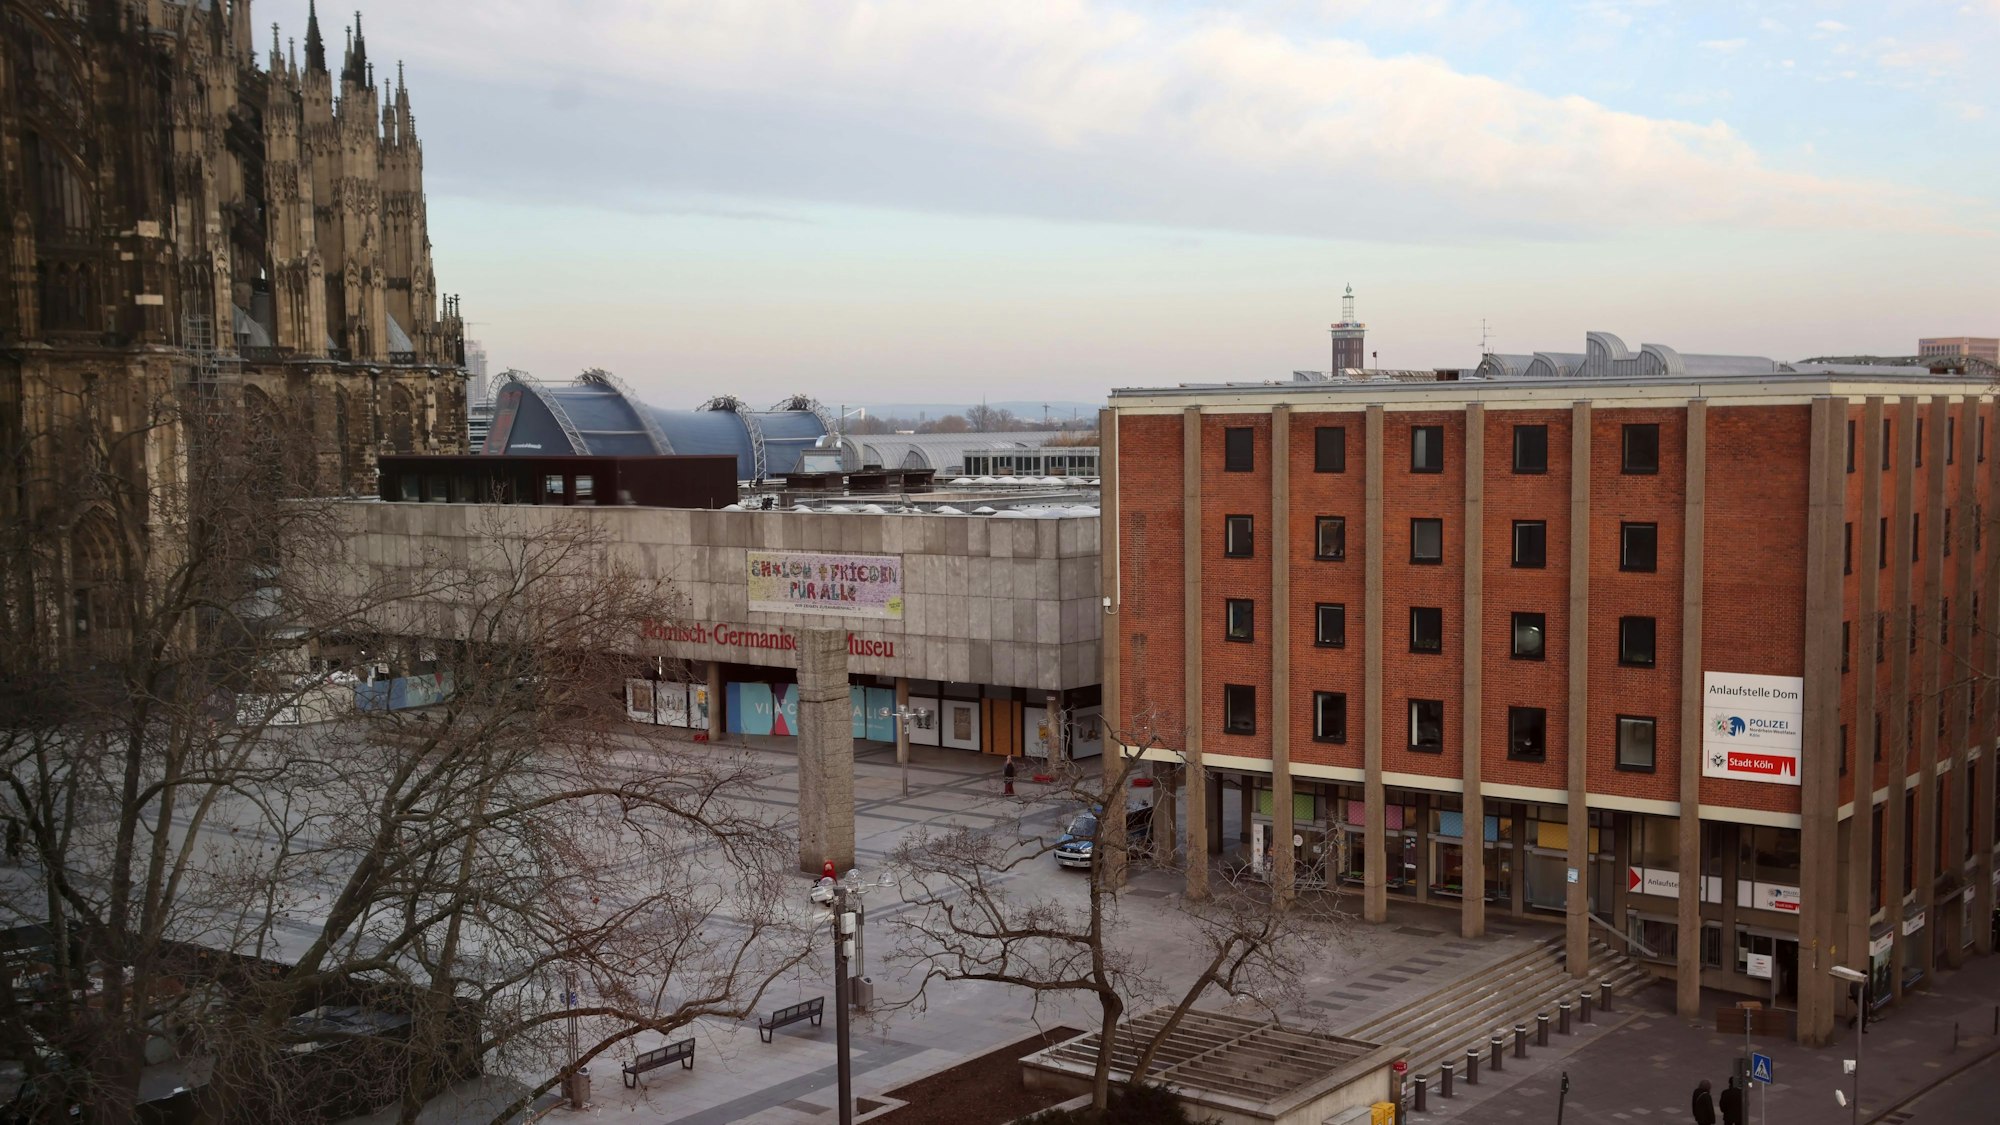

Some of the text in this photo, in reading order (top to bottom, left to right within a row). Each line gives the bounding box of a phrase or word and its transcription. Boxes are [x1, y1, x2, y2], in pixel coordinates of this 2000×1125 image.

[1709, 684, 1798, 699] Anlaufstelle Dom
[754, 702, 782, 716] VIA
[1749, 718, 1789, 730] POLIZEI
[1729, 757, 1774, 769] Stadt Köln
[1647, 878, 1679, 888] Anlaufste
